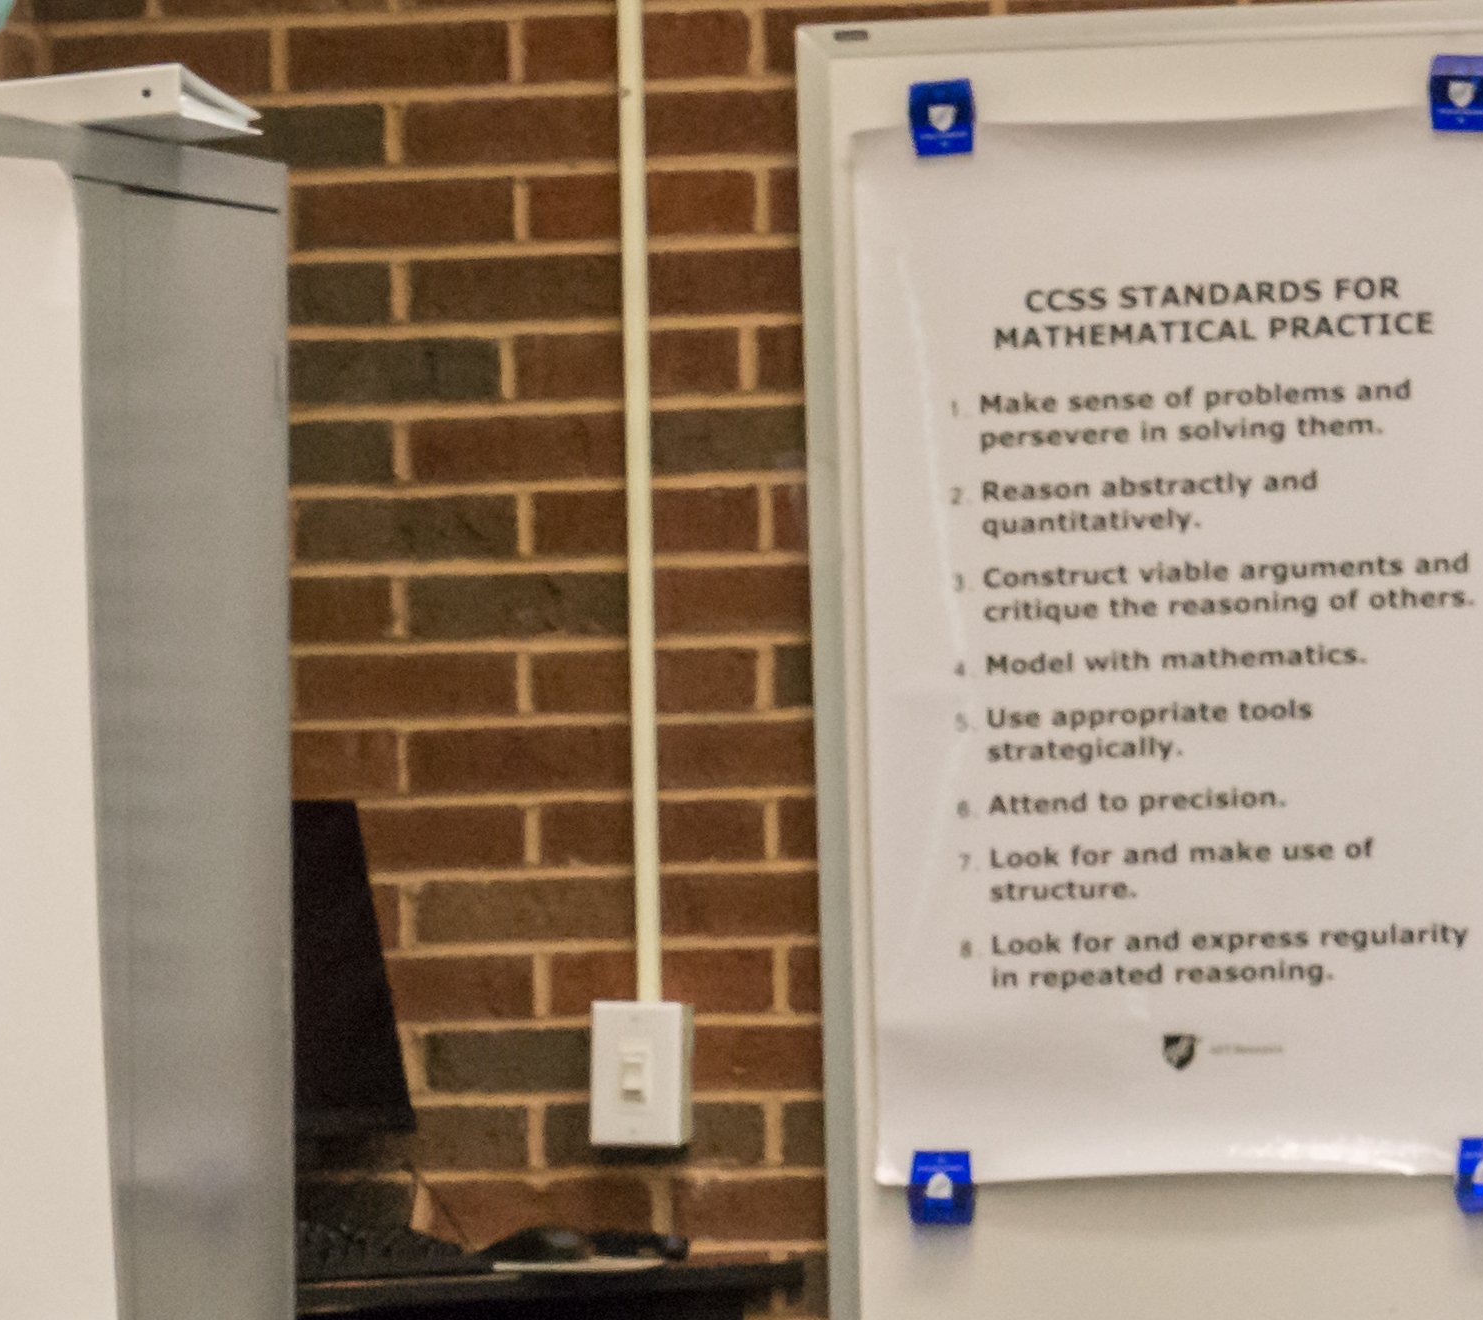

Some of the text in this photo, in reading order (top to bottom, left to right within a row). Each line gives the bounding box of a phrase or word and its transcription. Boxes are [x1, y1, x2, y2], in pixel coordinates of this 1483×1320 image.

[1024, 275, 1400, 314] CCSS STANDARDS FOR
[994, 311, 1434, 350] MATHEMATICAL PRACTICE
[979, 377, 1412, 415] Make sense of problems and
[979, 411, 1384, 454] persevere in solving them.
[980, 468, 1319, 503] Reason abstractly and
[981, 507, 1201, 540] quantitatively.
[982, 551, 1470, 590] Construct viable arguments and
[983, 586, 1474, 625] critique the reasoning of others.
[985, 644, 1367, 676] Model with mathematics.
[986, 698, 1314, 732] Use appropriate tools
[987, 735, 1183, 766] strategically.
[988, 787, 1286, 817] Attend to precision.
